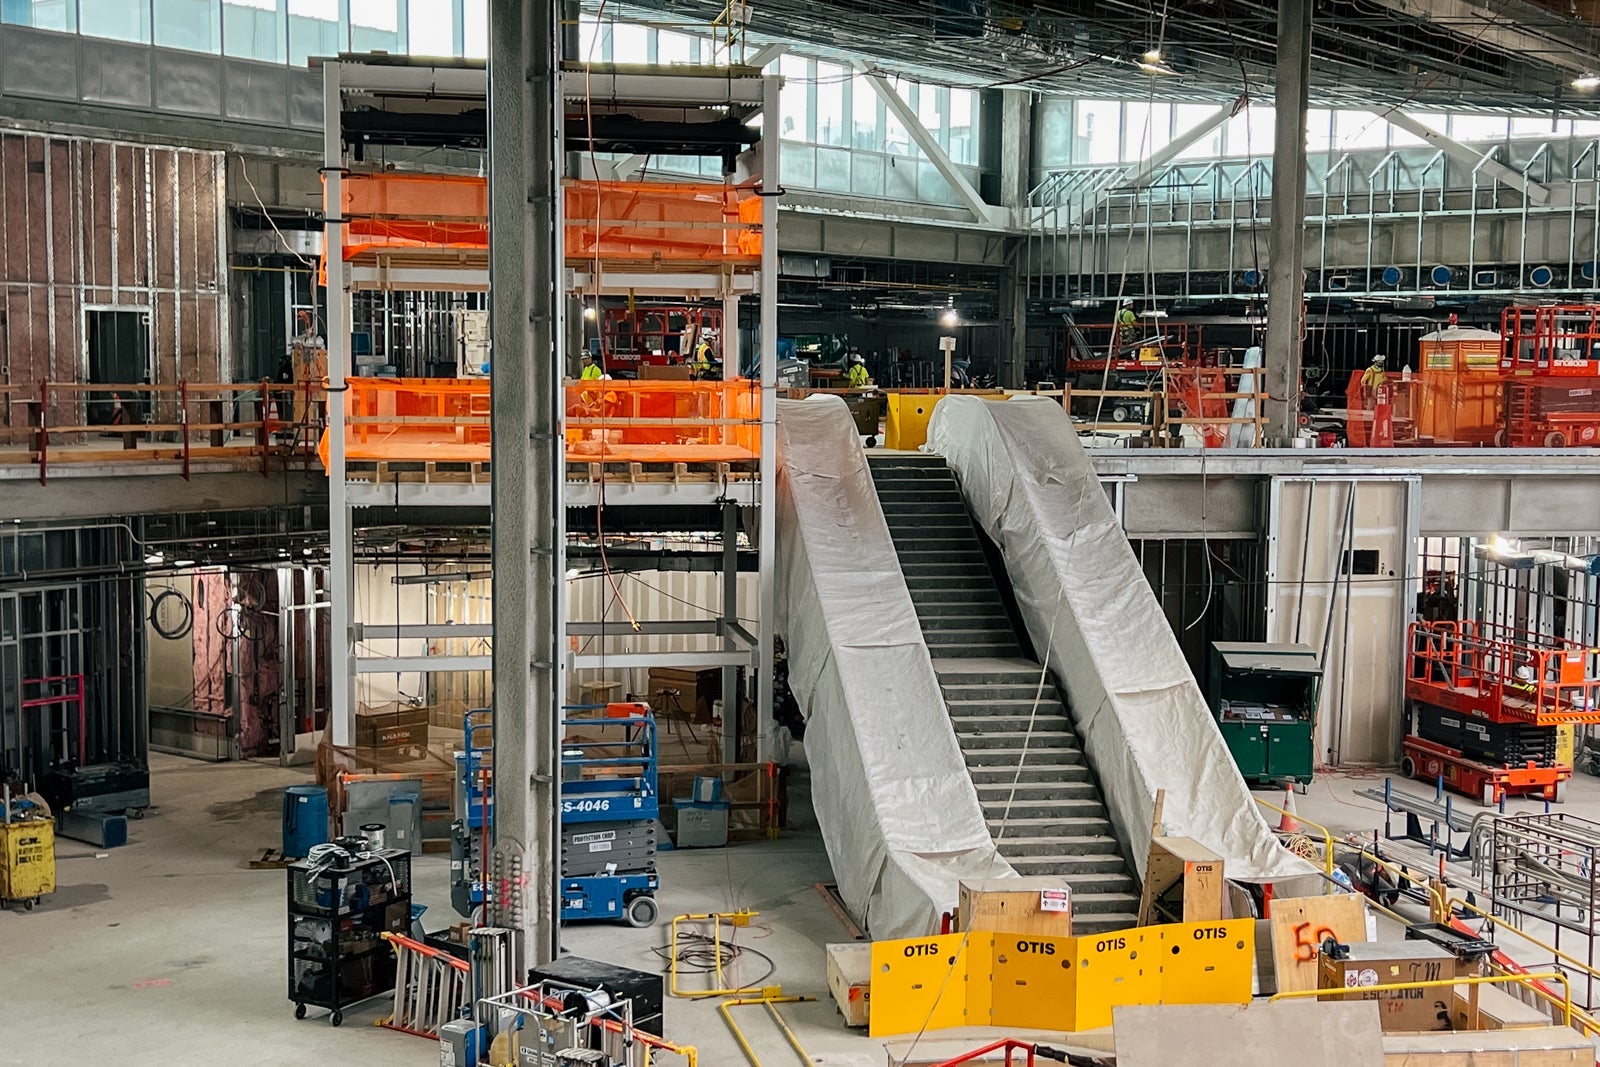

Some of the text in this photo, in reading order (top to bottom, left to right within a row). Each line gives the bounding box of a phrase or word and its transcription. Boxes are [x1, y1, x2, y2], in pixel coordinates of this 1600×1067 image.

[1193, 927, 1227, 940] OTIS
[904, 943, 939, 957] OTIS
[1016, 940, 1056, 956] OTIS
[1096, 937, 1126, 953] OTIS
